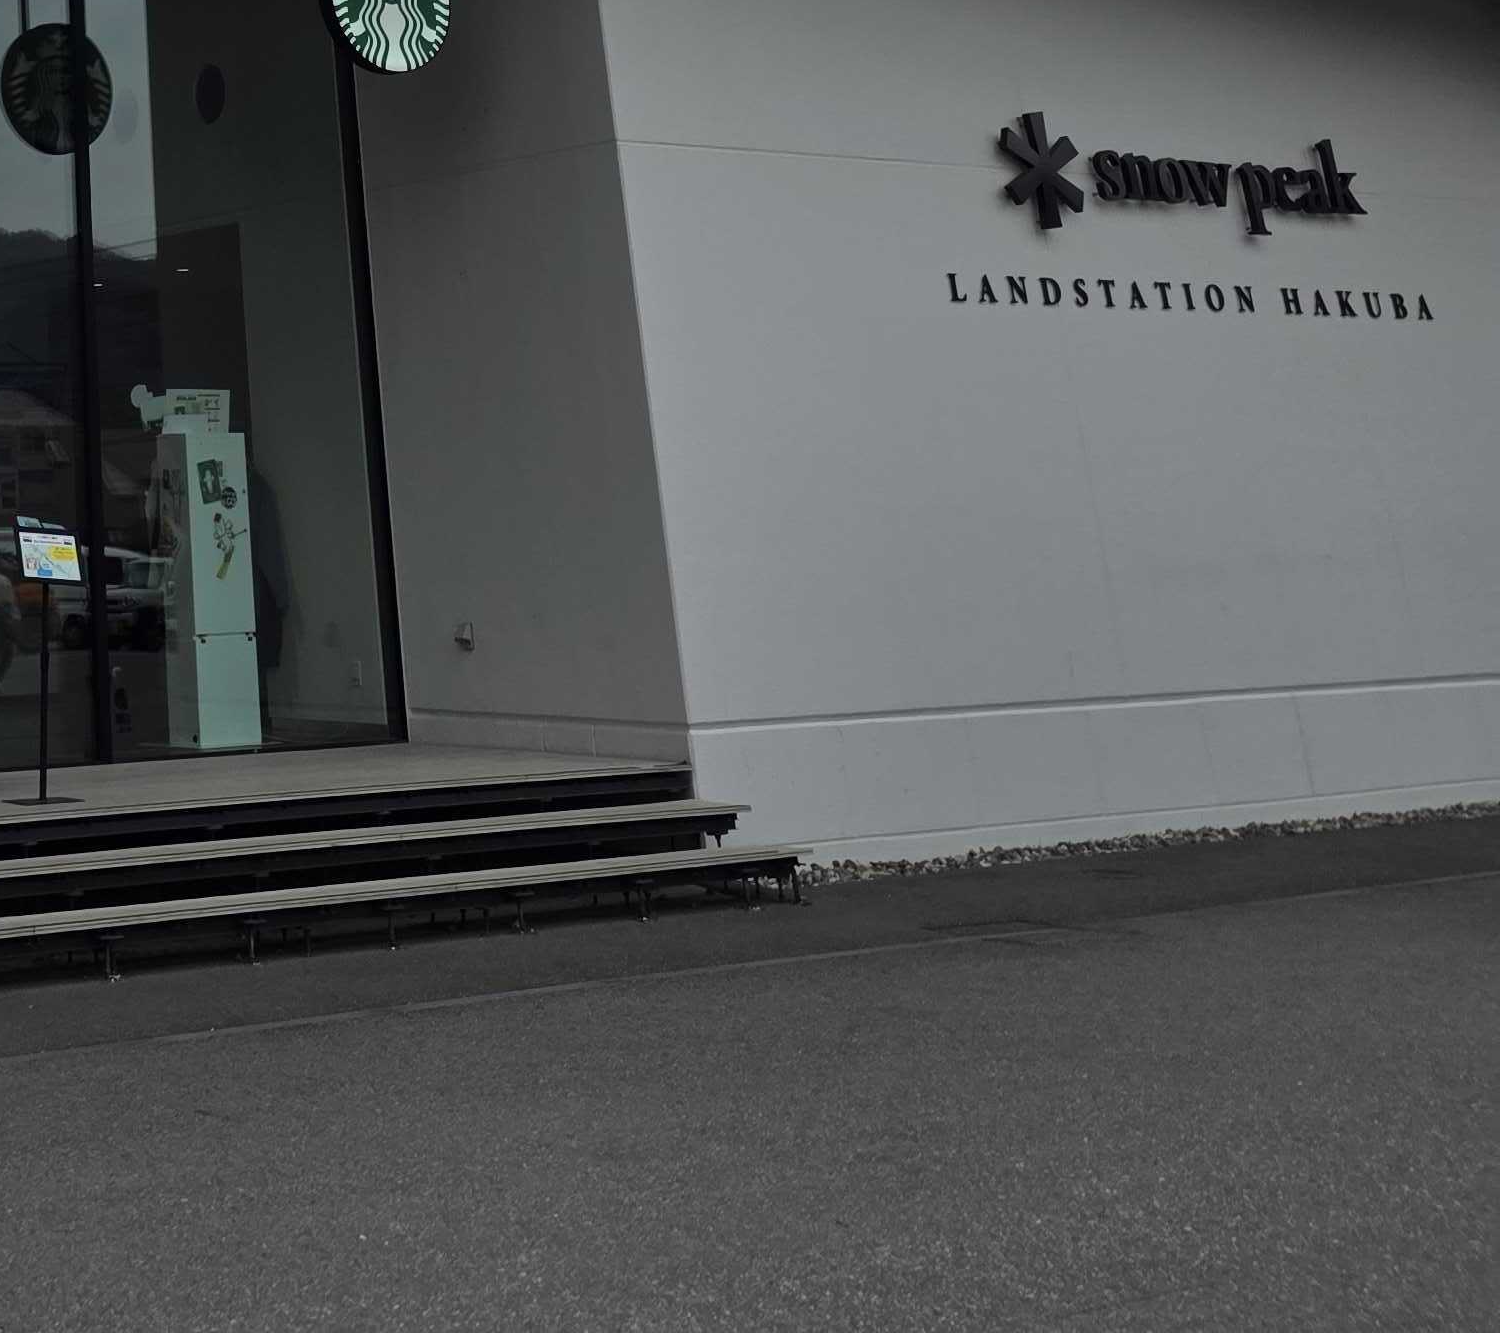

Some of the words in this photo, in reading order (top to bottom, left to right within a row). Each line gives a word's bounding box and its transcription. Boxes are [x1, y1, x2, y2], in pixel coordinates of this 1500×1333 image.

[1091, 148, 1232, 208] snow
[1235, 138, 1368, 236] peak
[947, 273, 1256, 313] LANDSTATION
[1280, 287, 1435, 320] HAKUBA
